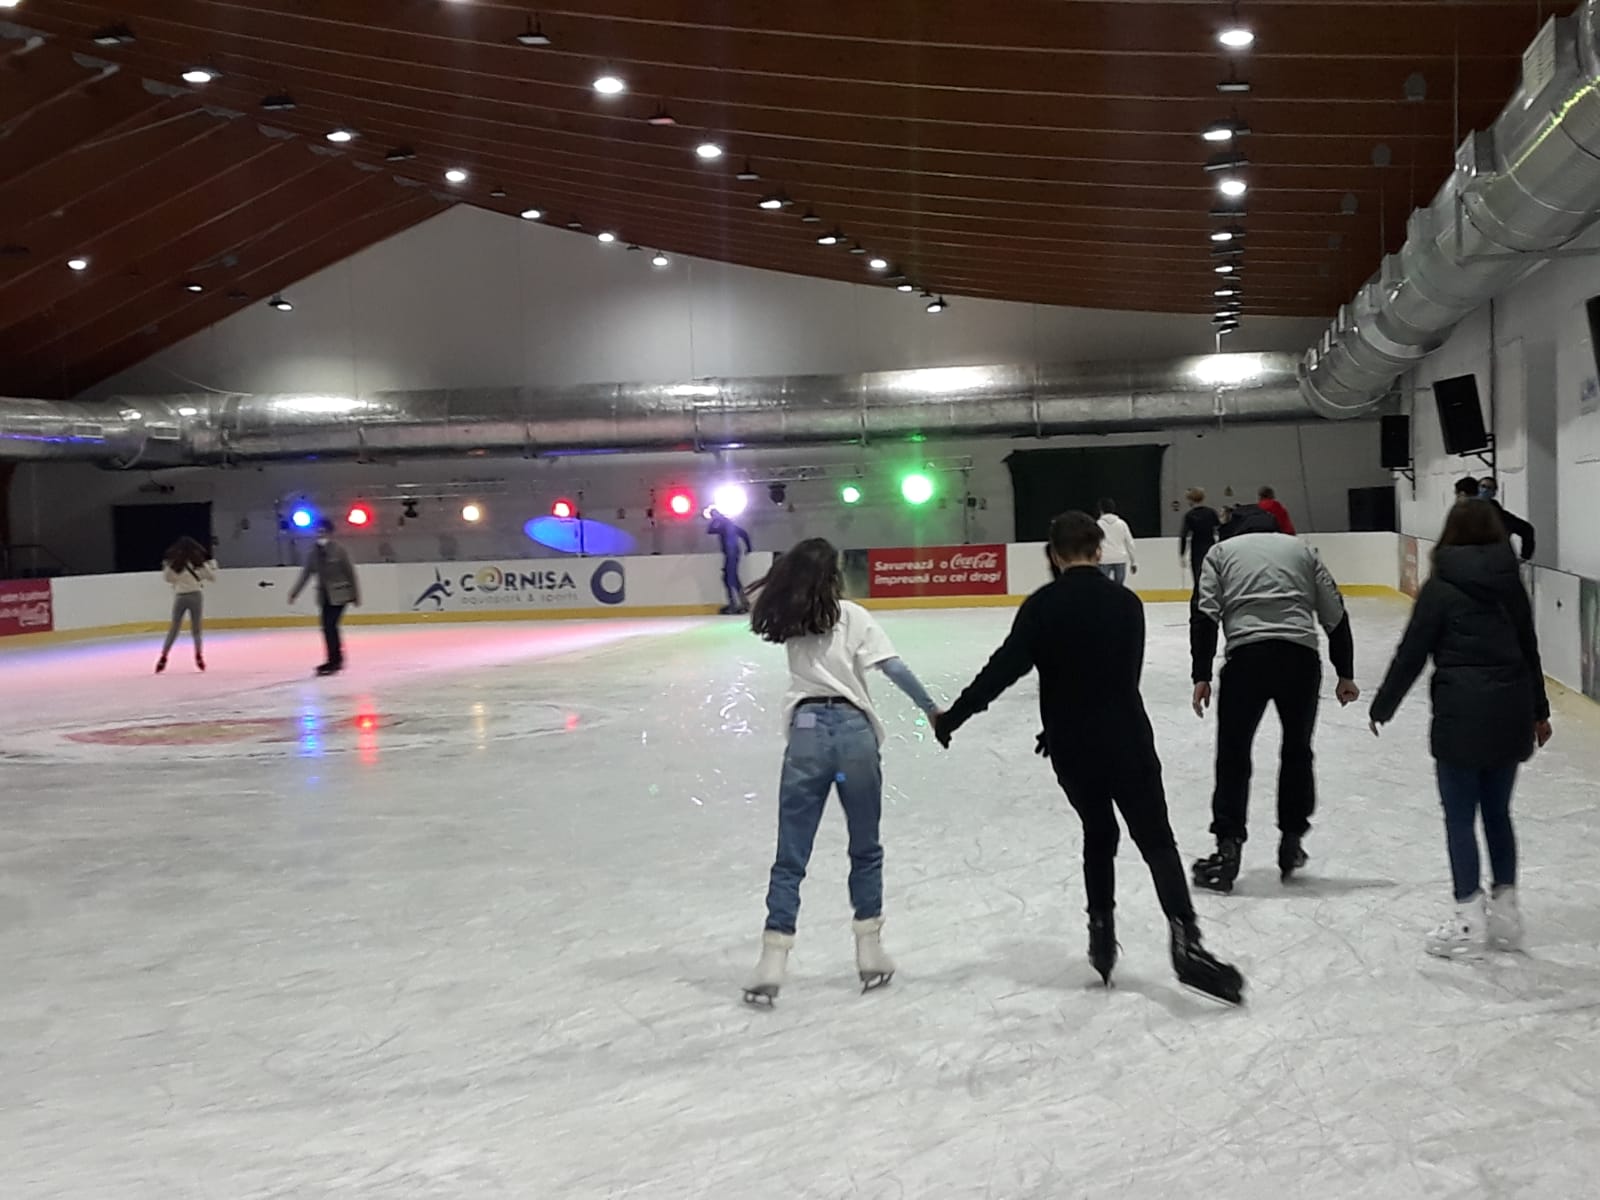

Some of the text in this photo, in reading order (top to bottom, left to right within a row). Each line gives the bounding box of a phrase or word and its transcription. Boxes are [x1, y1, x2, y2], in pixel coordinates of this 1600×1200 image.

[939, 561, 949, 569] o
[932, 574, 947, 583] cu
[949, 572, 968, 583] cei
[969, 571, 1002, 583] dragi
